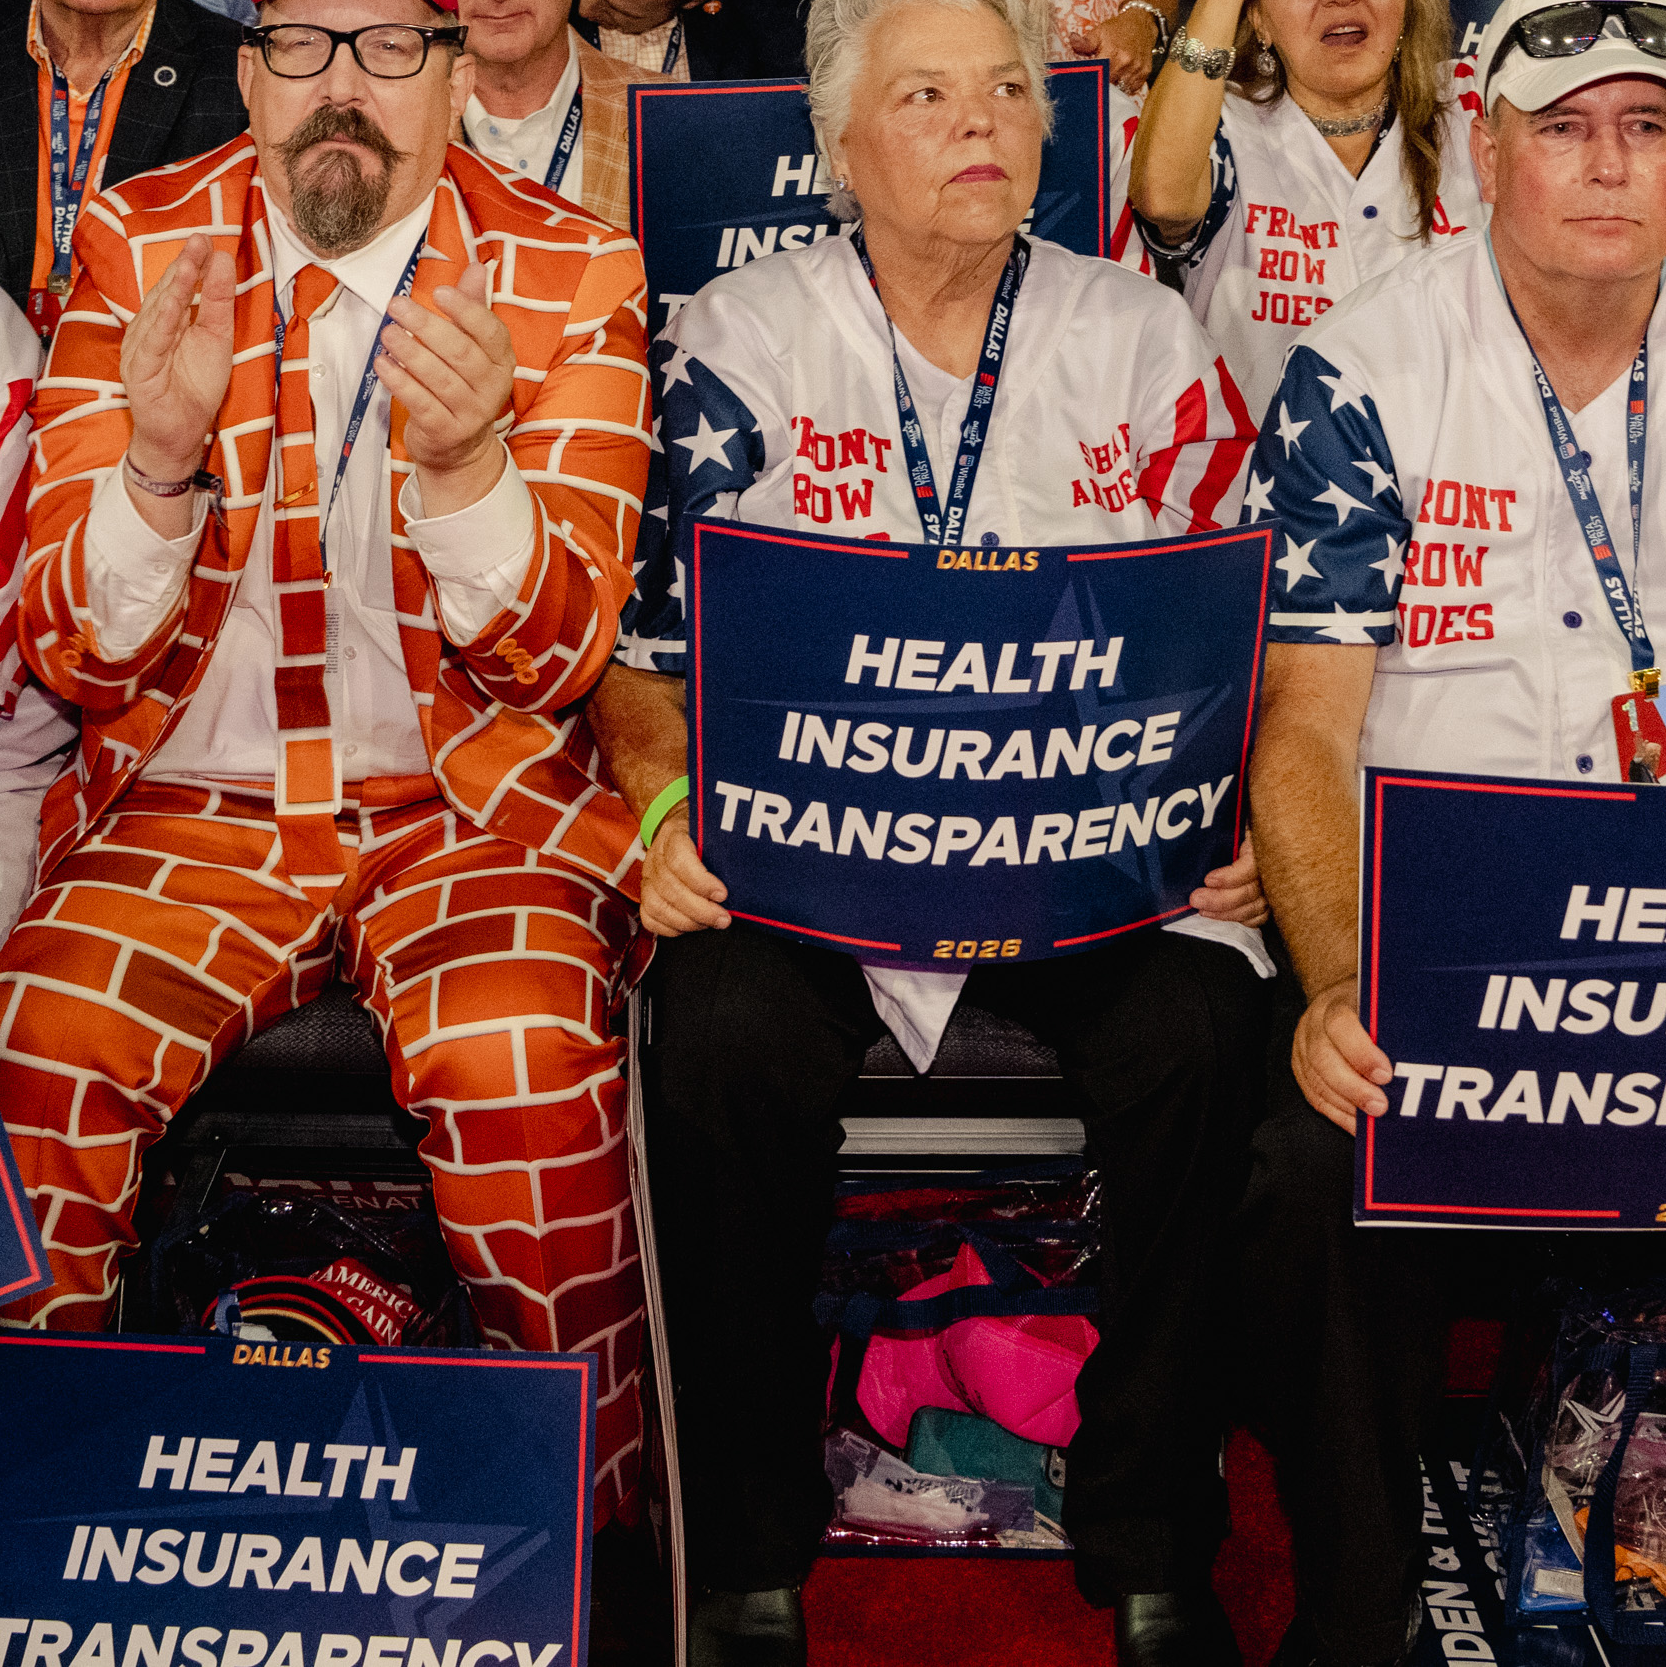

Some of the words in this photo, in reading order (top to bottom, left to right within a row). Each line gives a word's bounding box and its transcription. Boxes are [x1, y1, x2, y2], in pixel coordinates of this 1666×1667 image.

[560, 105, 581, 154] DALLAS
[1245, 204, 1339, 249] FRONT
[1259, 249, 1326, 284] ROW
[986, 303, 1009, 362] DALLAS
[1250, 292, 1334, 327] JOES
[793, 473, 874, 522] ROW
[936, 550, 1039, 571] DALLAS
[1402, 541, 1487, 588] ROW
[844, 634, 1124, 695] HEALTH
[778, 711, 1181, 781] INSURANCE
[714, 773, 1234, 866] TRANSPARENCY
[933, 939, 1022, 959] 2026
[233, 1345, 331, 1369] DALLAS
[138, 1436, 417, 1501] HEALTH
[63, 1526, 485, 1599] INSURANCE
